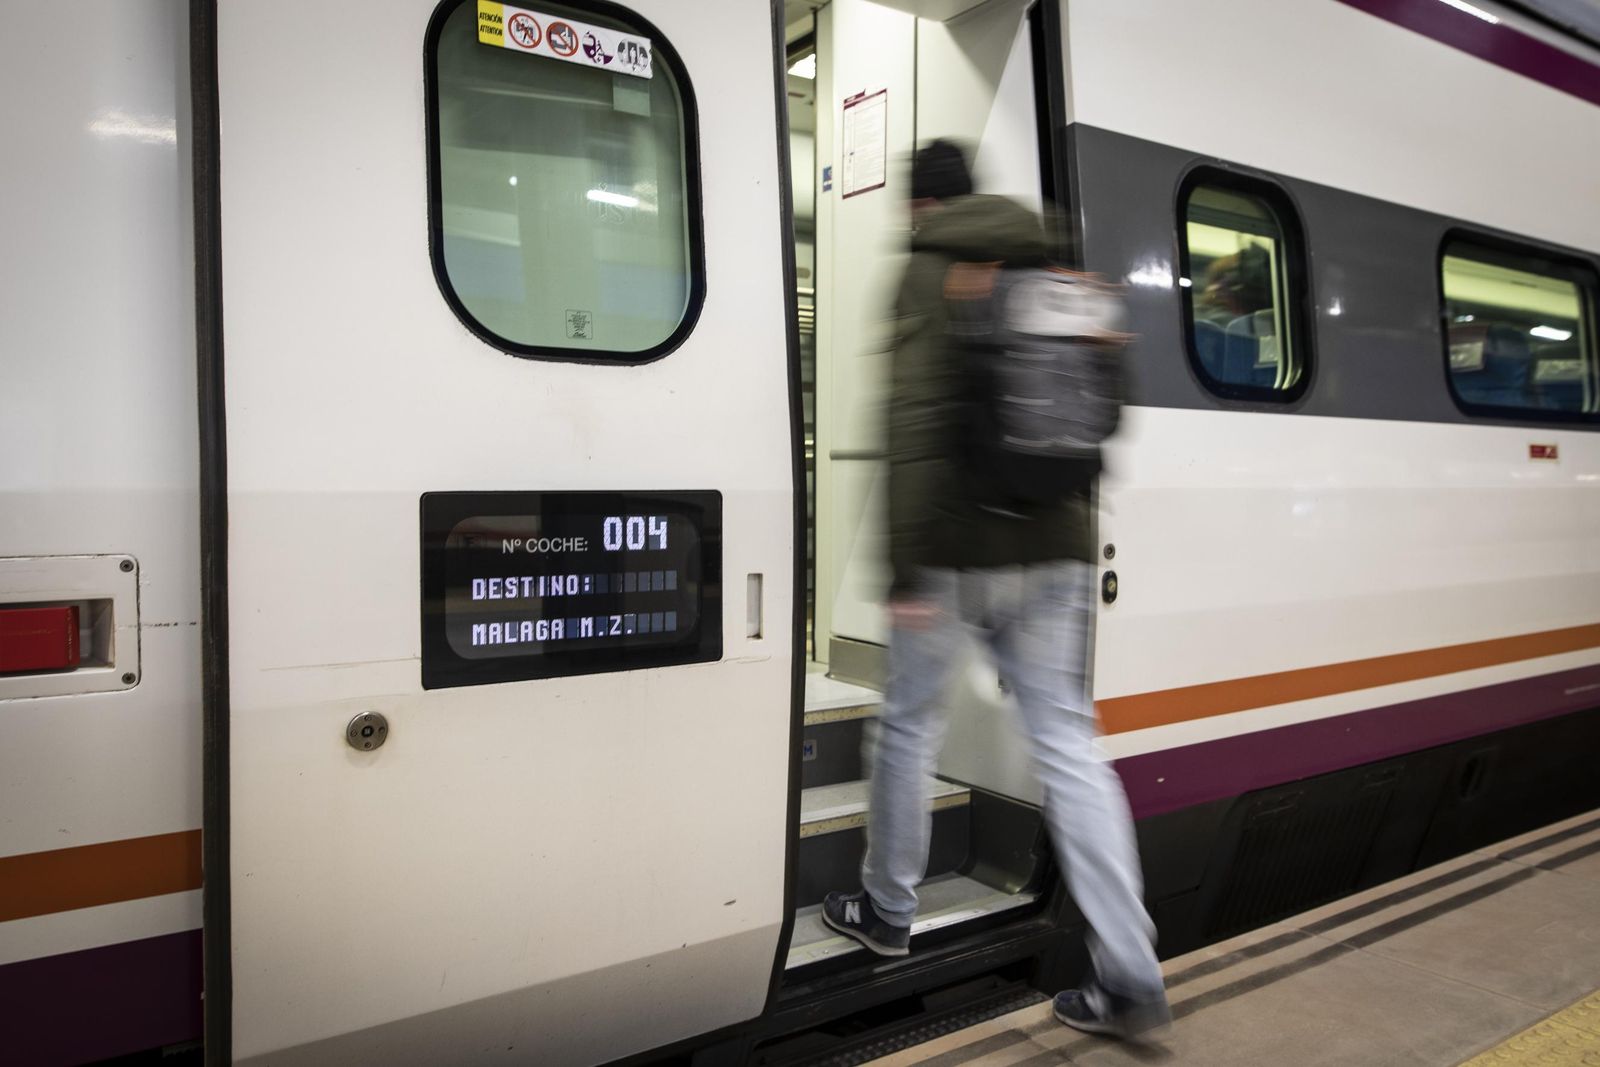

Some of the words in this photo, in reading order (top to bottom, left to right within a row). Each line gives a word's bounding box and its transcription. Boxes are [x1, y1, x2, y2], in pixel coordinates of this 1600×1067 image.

[526, 537, 588, 553] COCHE:
[603, 516, 667, 551] 004
[472, 574, 590, 600] DESTINO:
[472, 619, 564, 646] MALAGA
[845, 901, 861, 924] N
